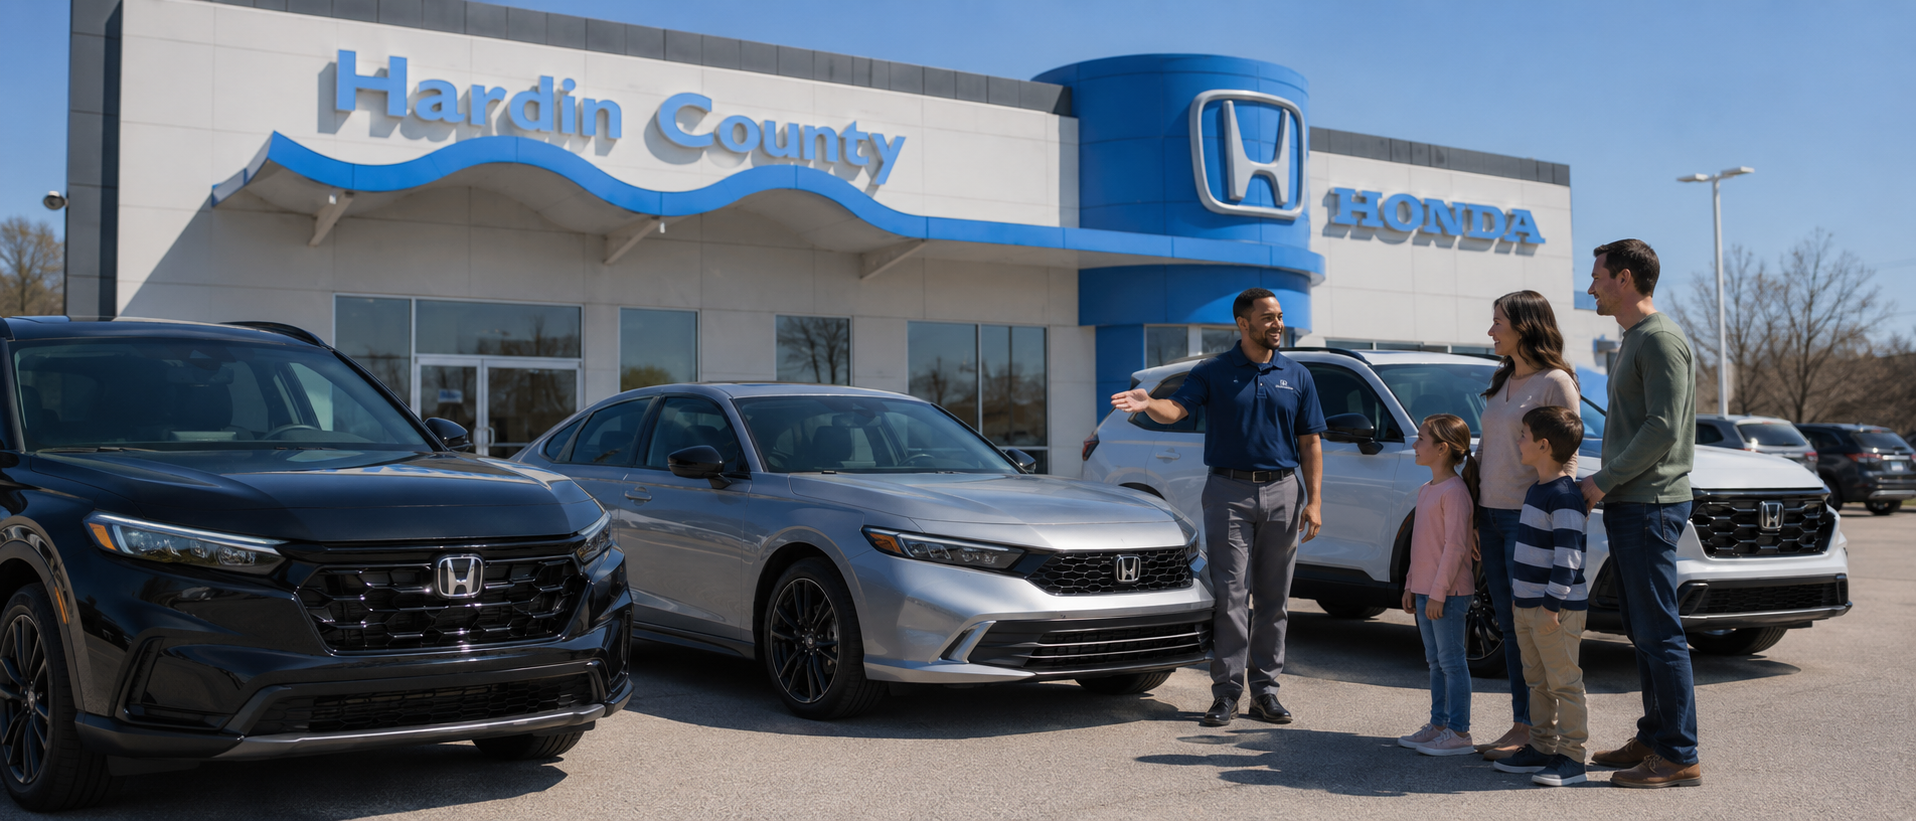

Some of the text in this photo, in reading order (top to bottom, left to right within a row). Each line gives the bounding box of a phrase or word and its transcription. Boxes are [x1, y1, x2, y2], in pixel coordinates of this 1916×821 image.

[335, 49, 907, 186] Hardin County
[1328, 187, 1546, 244] HONDA
